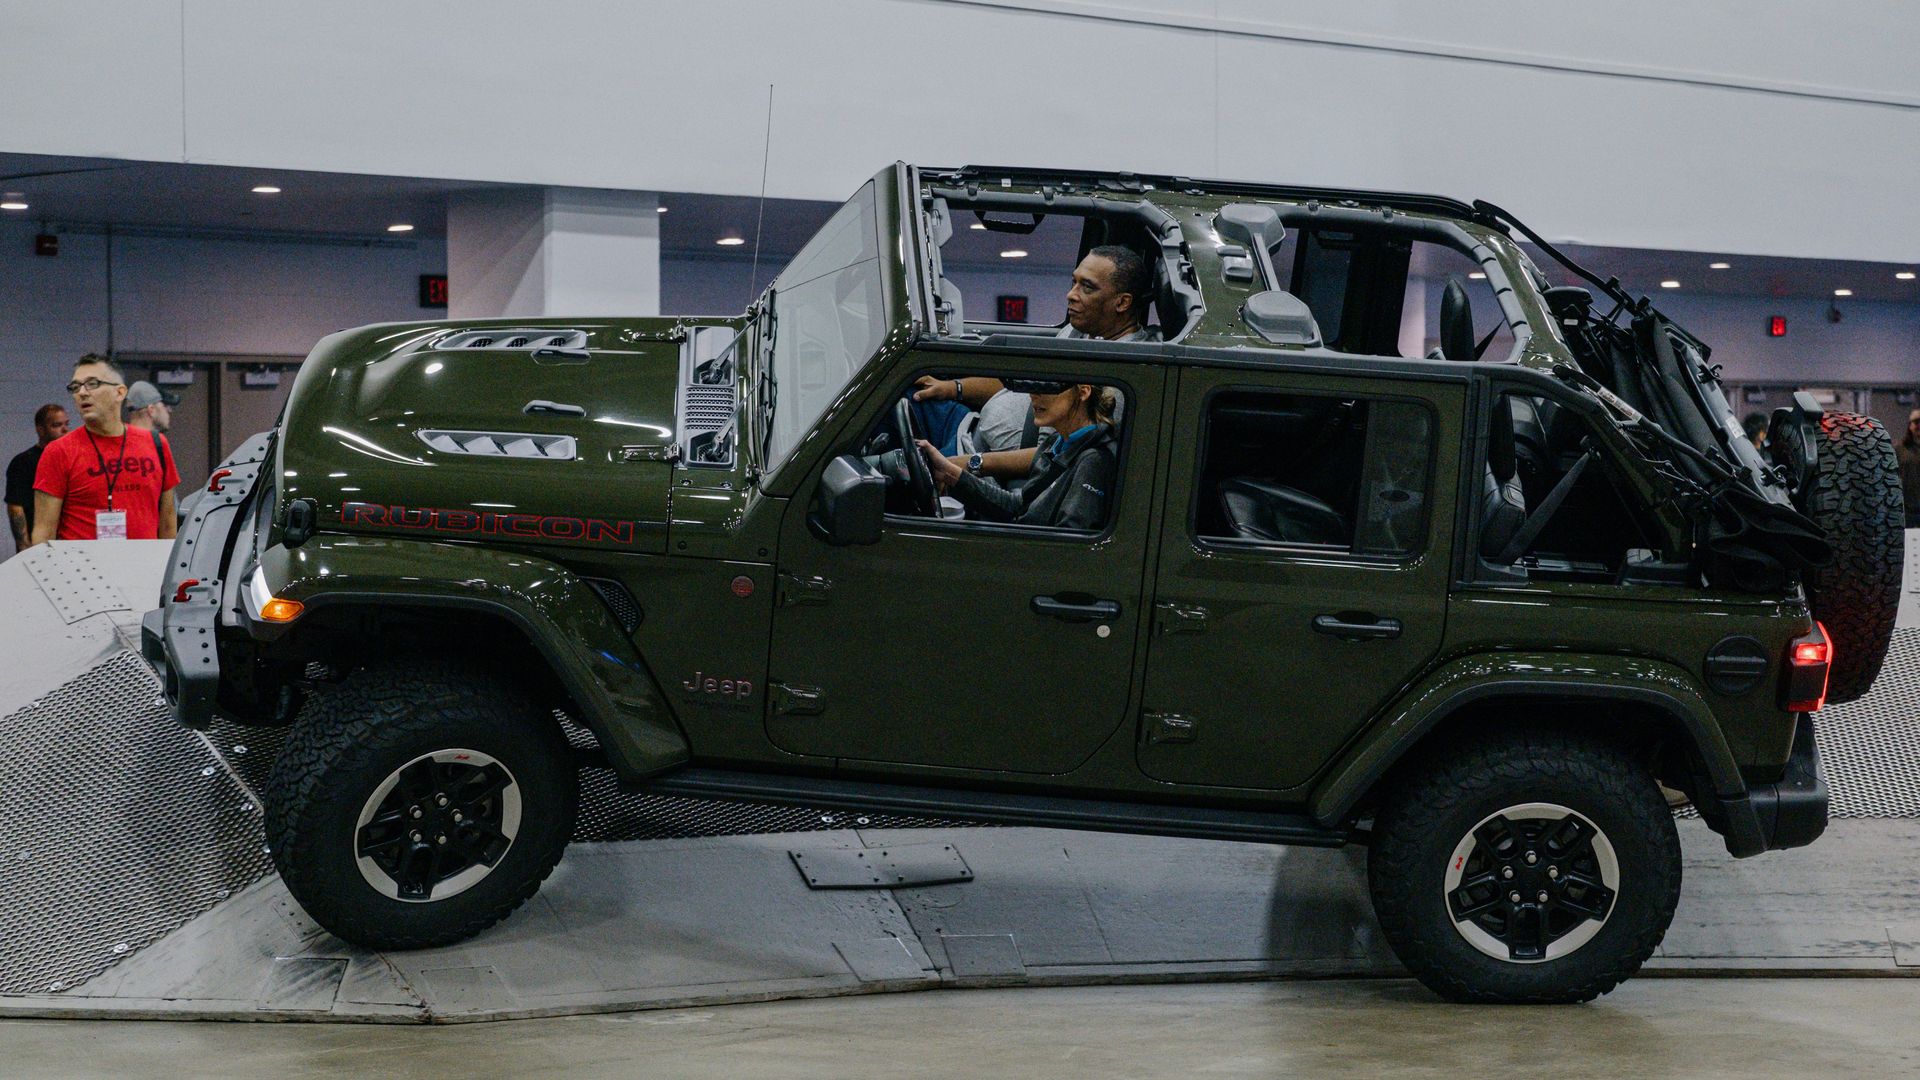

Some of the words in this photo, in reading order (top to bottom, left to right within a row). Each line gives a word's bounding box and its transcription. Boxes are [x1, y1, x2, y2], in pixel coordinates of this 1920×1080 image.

[87, 456, 155, 477] Jeep
[341, 501, 635, 544] RUBICON
[683, 671, 752, 700] Jeep
